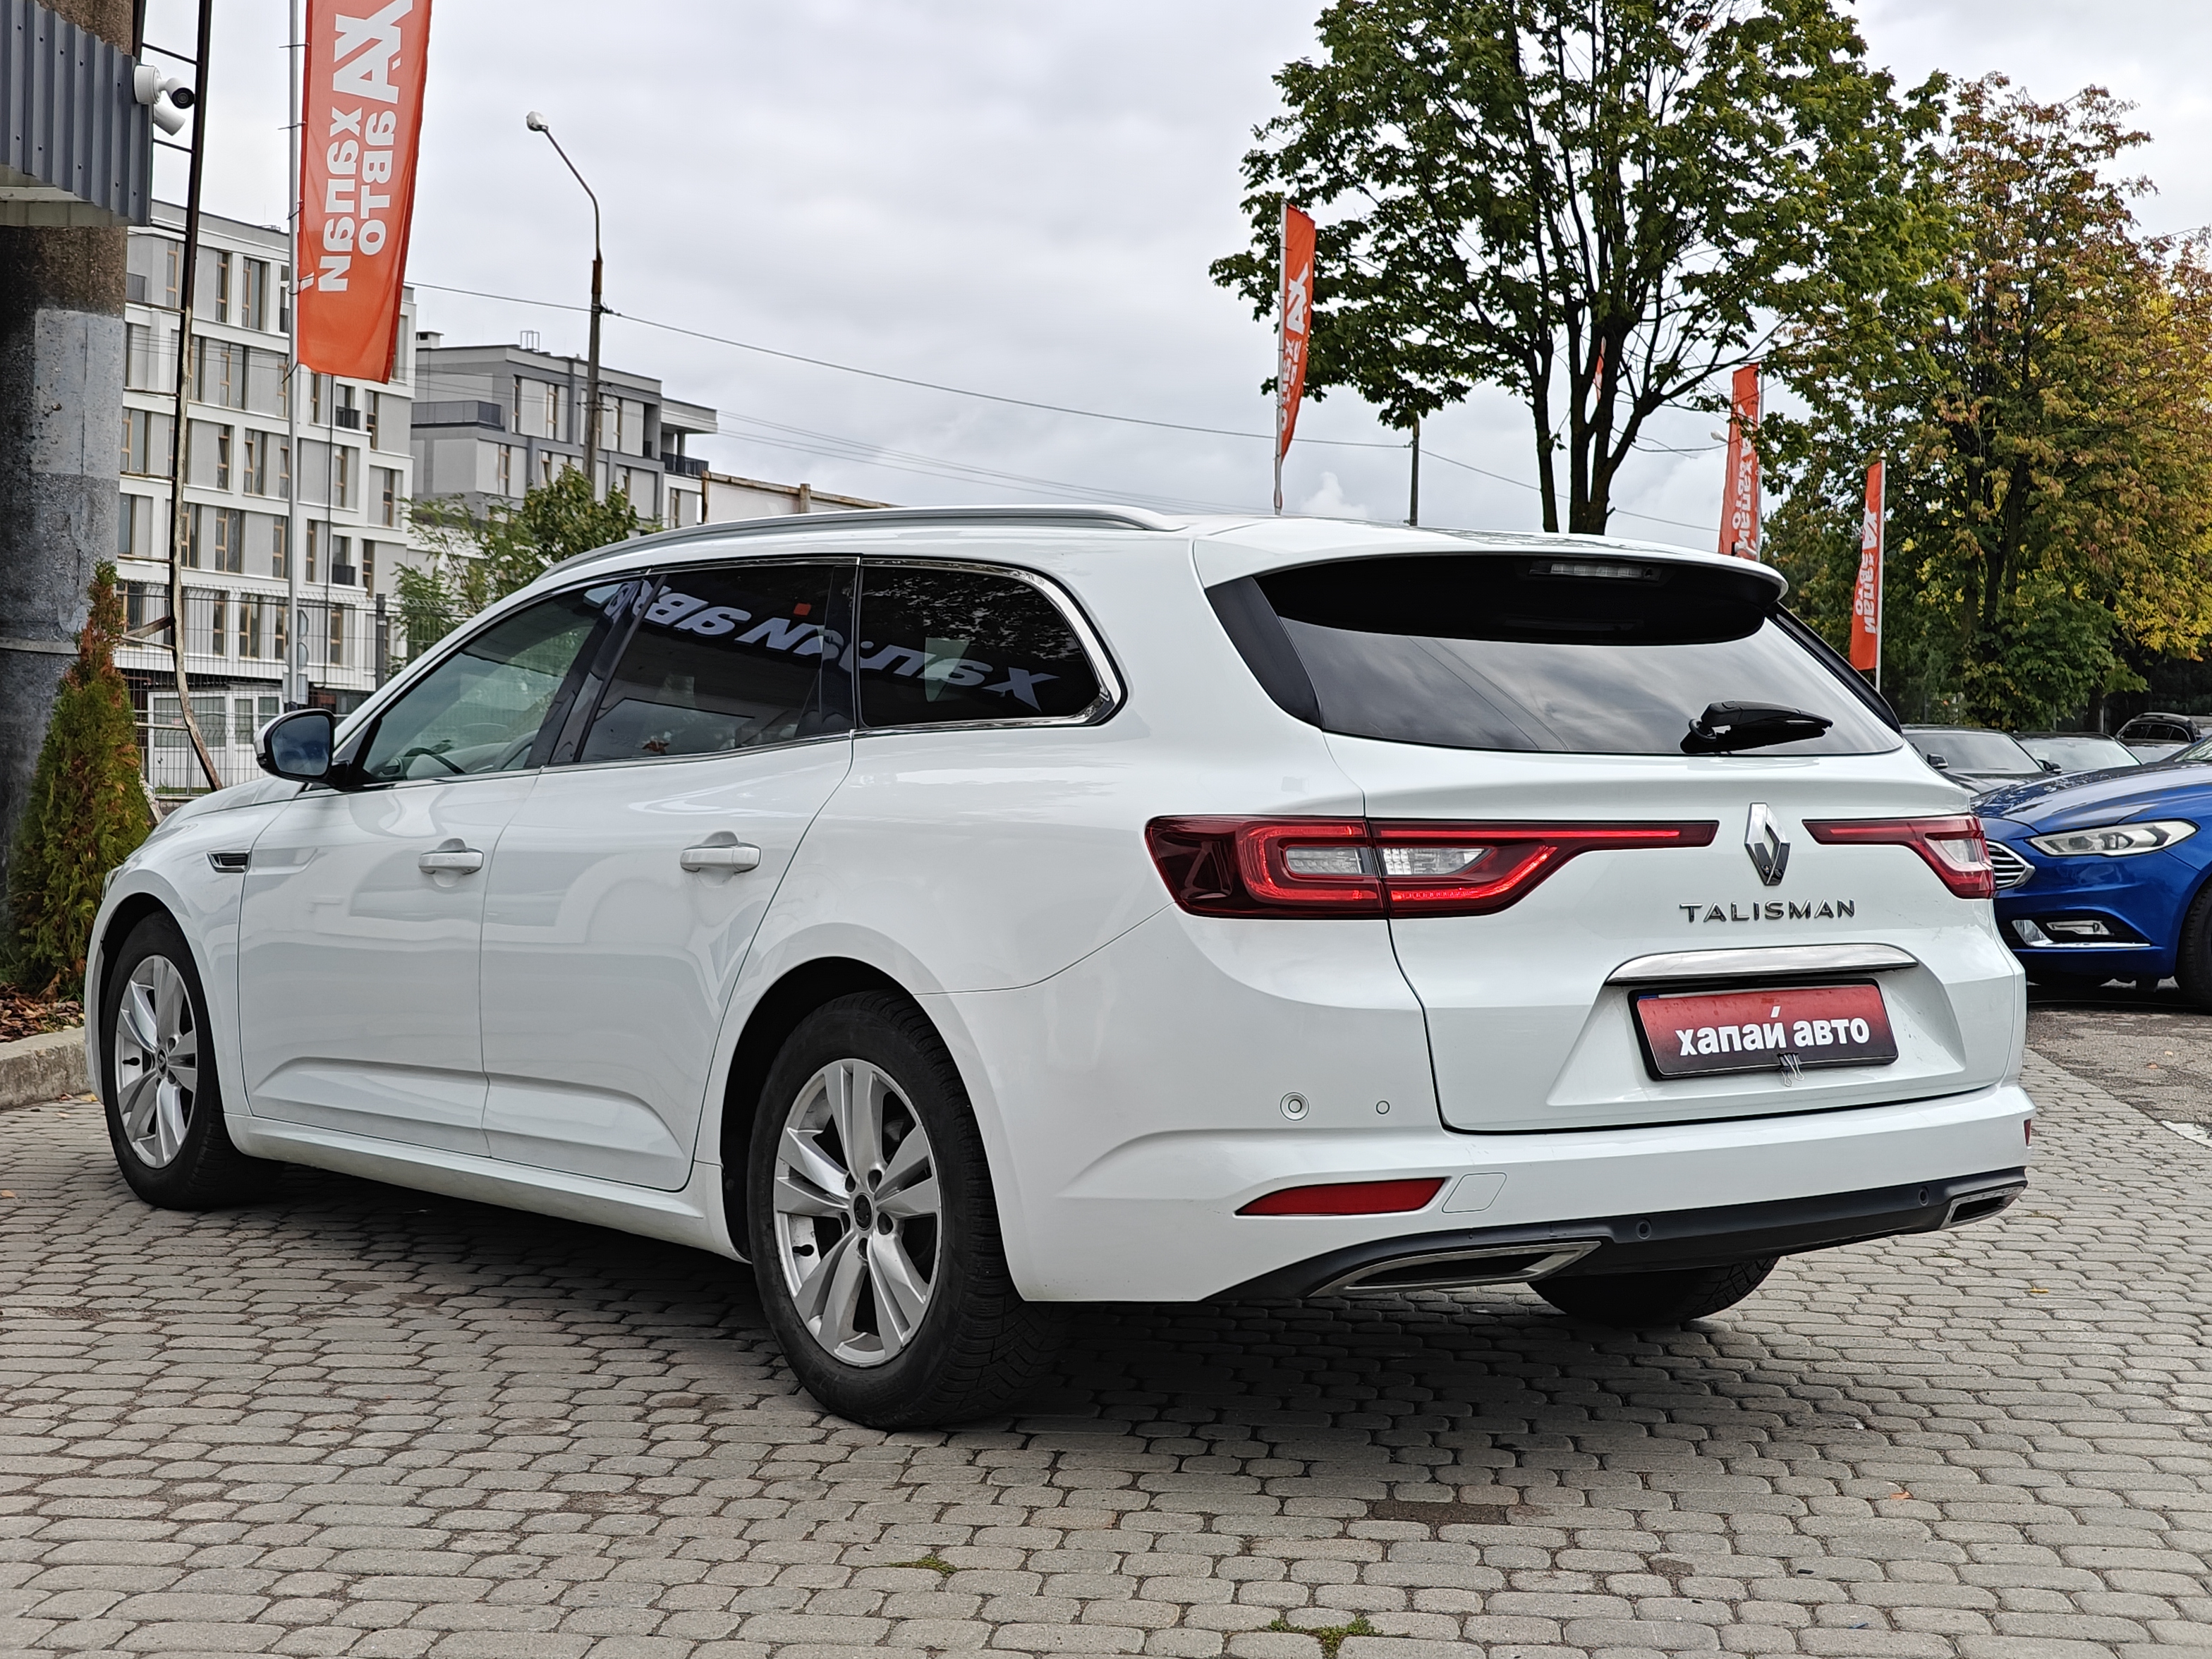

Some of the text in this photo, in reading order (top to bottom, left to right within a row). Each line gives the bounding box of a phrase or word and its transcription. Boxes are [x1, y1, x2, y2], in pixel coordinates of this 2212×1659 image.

[1679, 898, 1857, 923] TALISMAN
[1675, 1006, 1871, 1057] хапай авто
